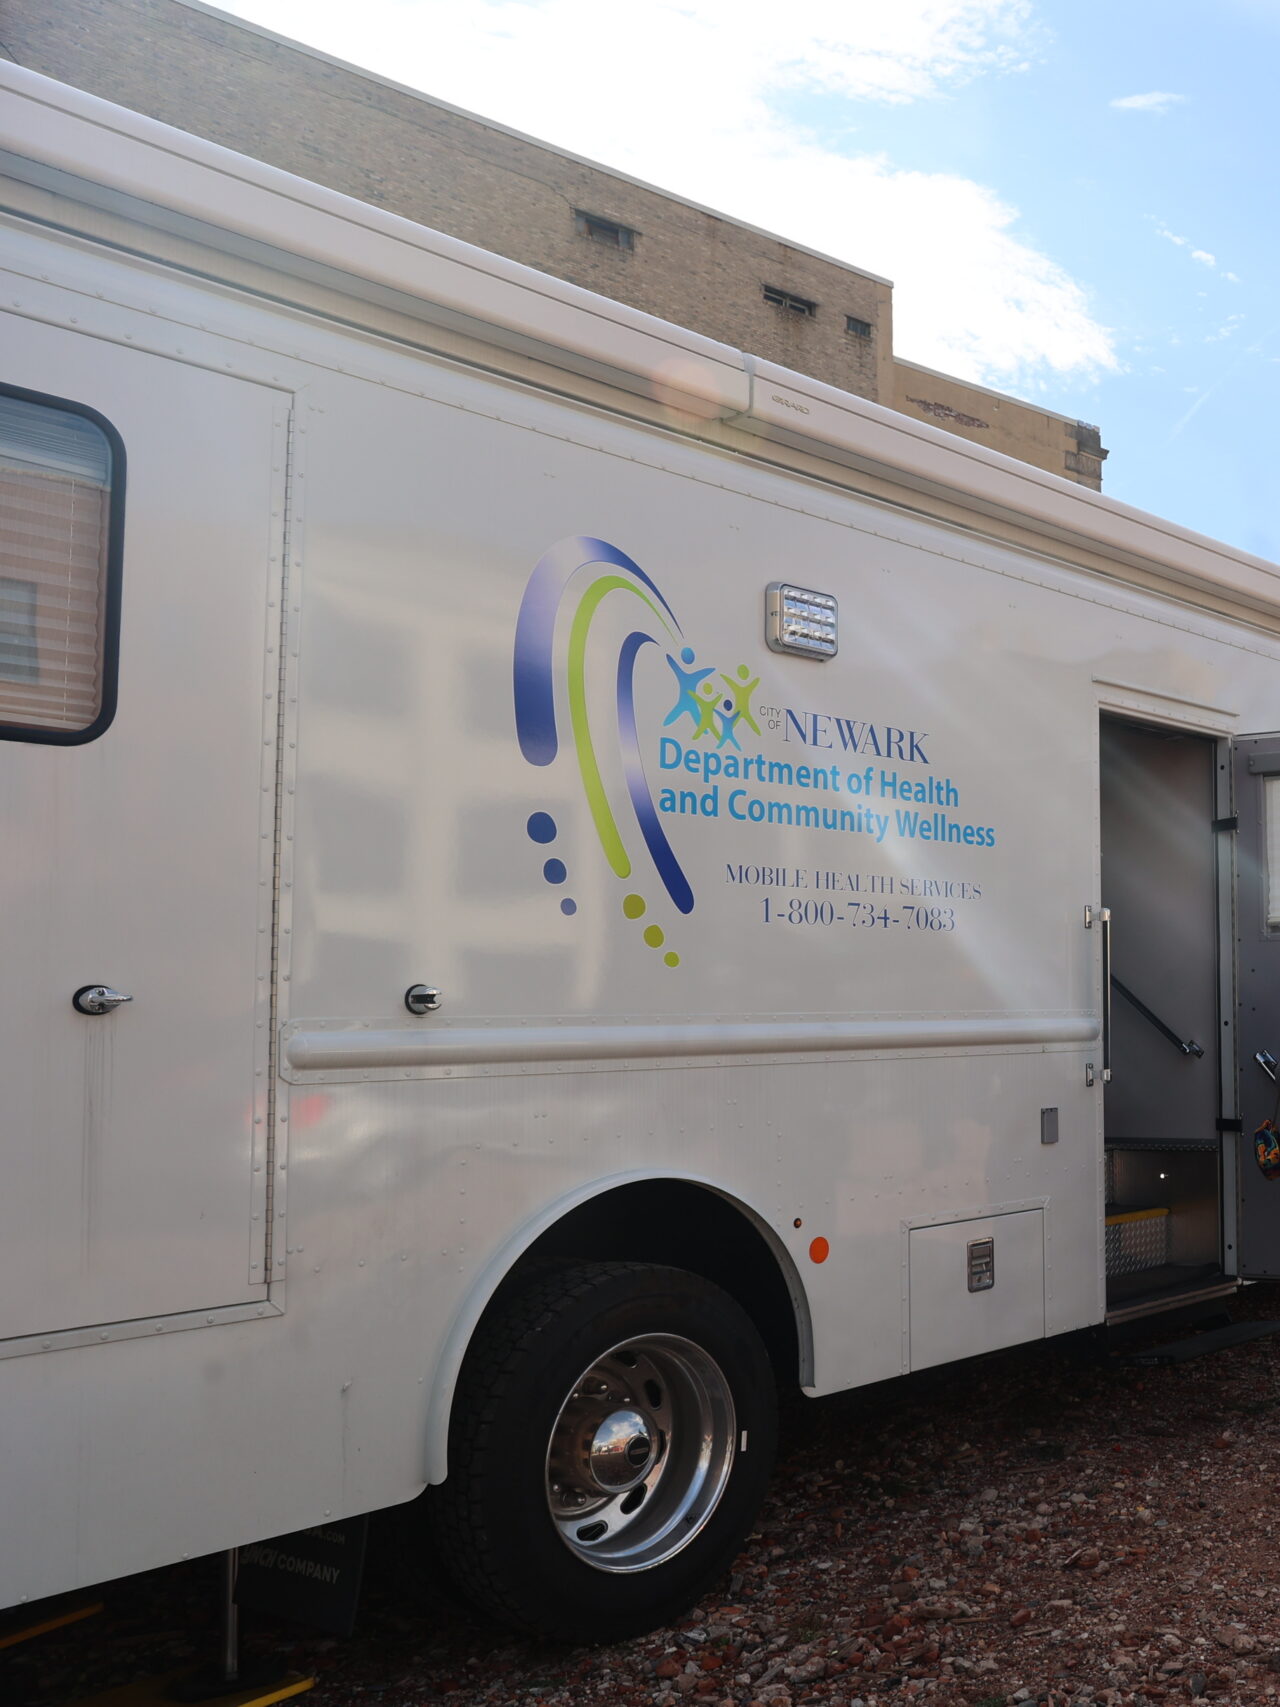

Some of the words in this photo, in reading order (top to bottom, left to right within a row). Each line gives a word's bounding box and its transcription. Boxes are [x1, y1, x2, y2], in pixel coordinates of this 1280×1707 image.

[759, 705, 782, 718] CITY
[767, 719, 782, 730] OF
[782, 707, 931, 765] NEWARK
[659, 736, 841, 792] Department
[846, 766, 874, 796] of
[880, 769, 959, 808] Health
[659, 785, 719, 817] and
[727, 789, 890, 843] Community
[894, 808, 996, 847] Wellness
[725, 863, 809, 888] MOBILE
[815, 870, 894, 895] HEALTH
[899, 878, 982, 900] SERVICES
[759, 897, 955, 931] 1-800-734-7083
[277, 1553, 341, 1585] COMPANY
